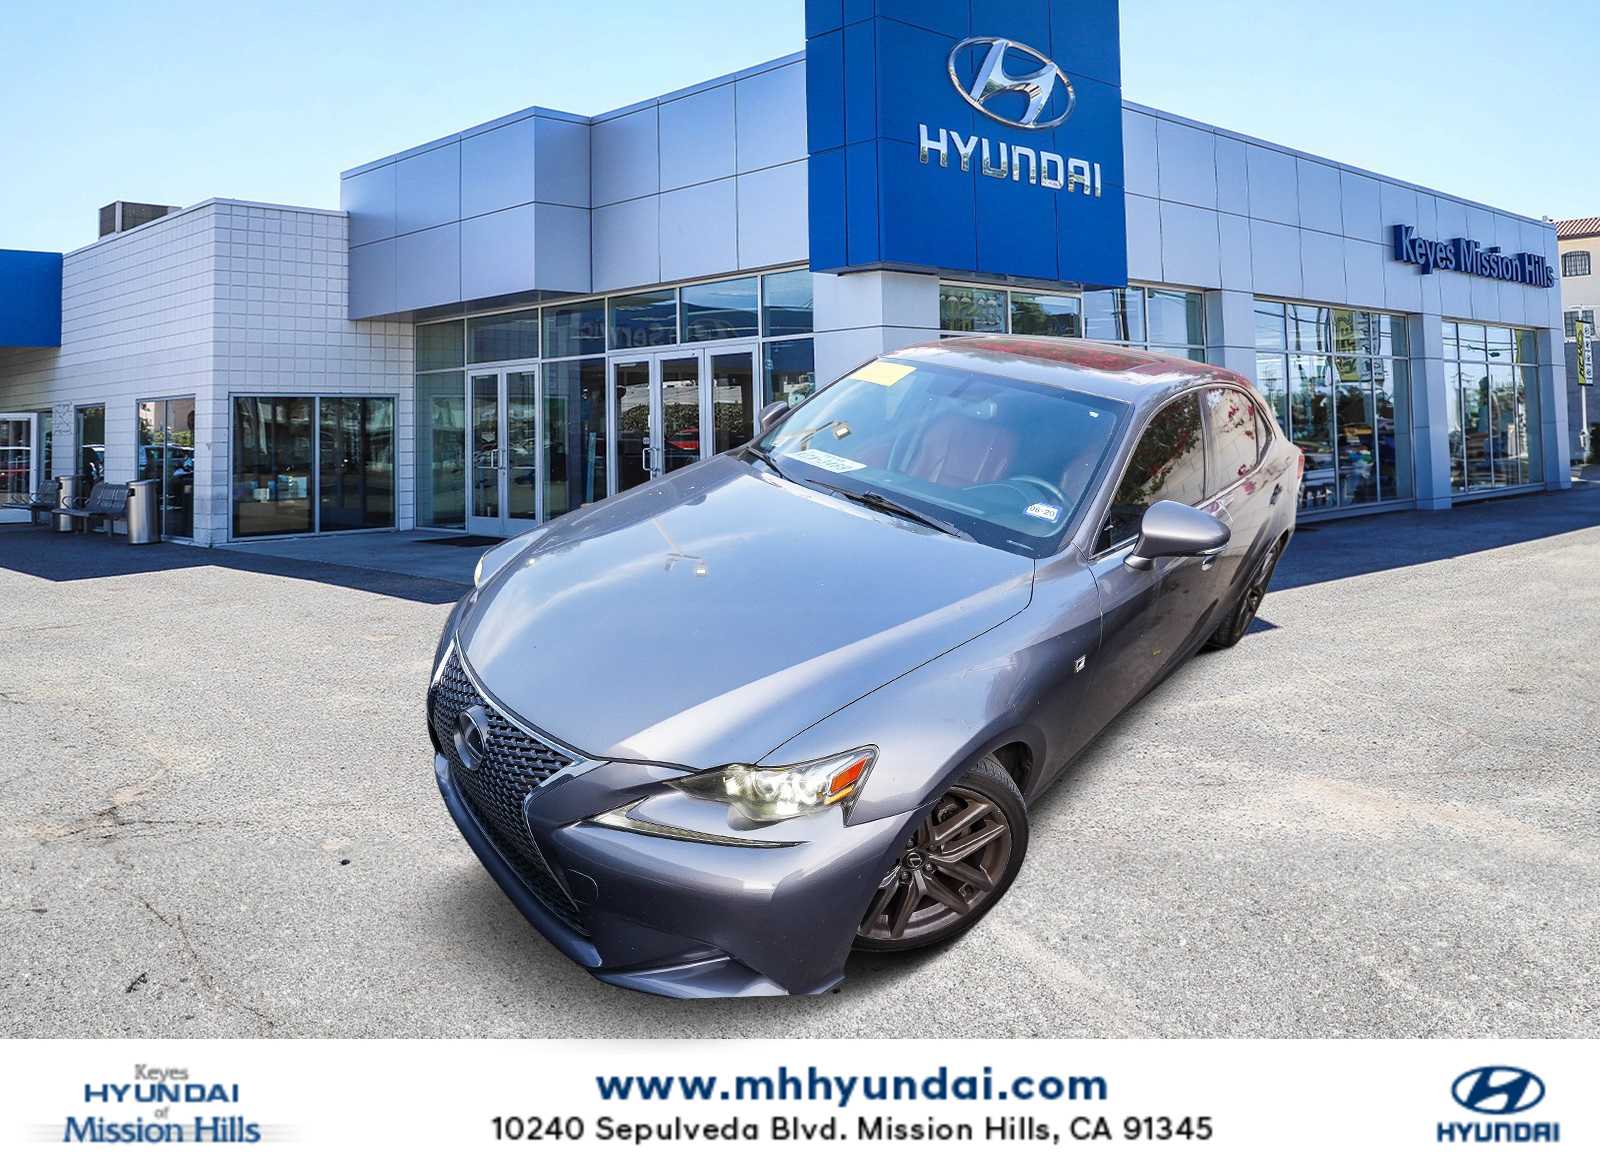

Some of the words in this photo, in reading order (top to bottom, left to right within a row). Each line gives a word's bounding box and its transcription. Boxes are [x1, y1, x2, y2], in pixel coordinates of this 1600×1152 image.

[918, 124, 1102, 198] HYUNDAI
[1396, 225, 1455, 274] Keyes
[1457, 239, 1521, 283] Mission
[1522, 253, 1555, 288] Hills
